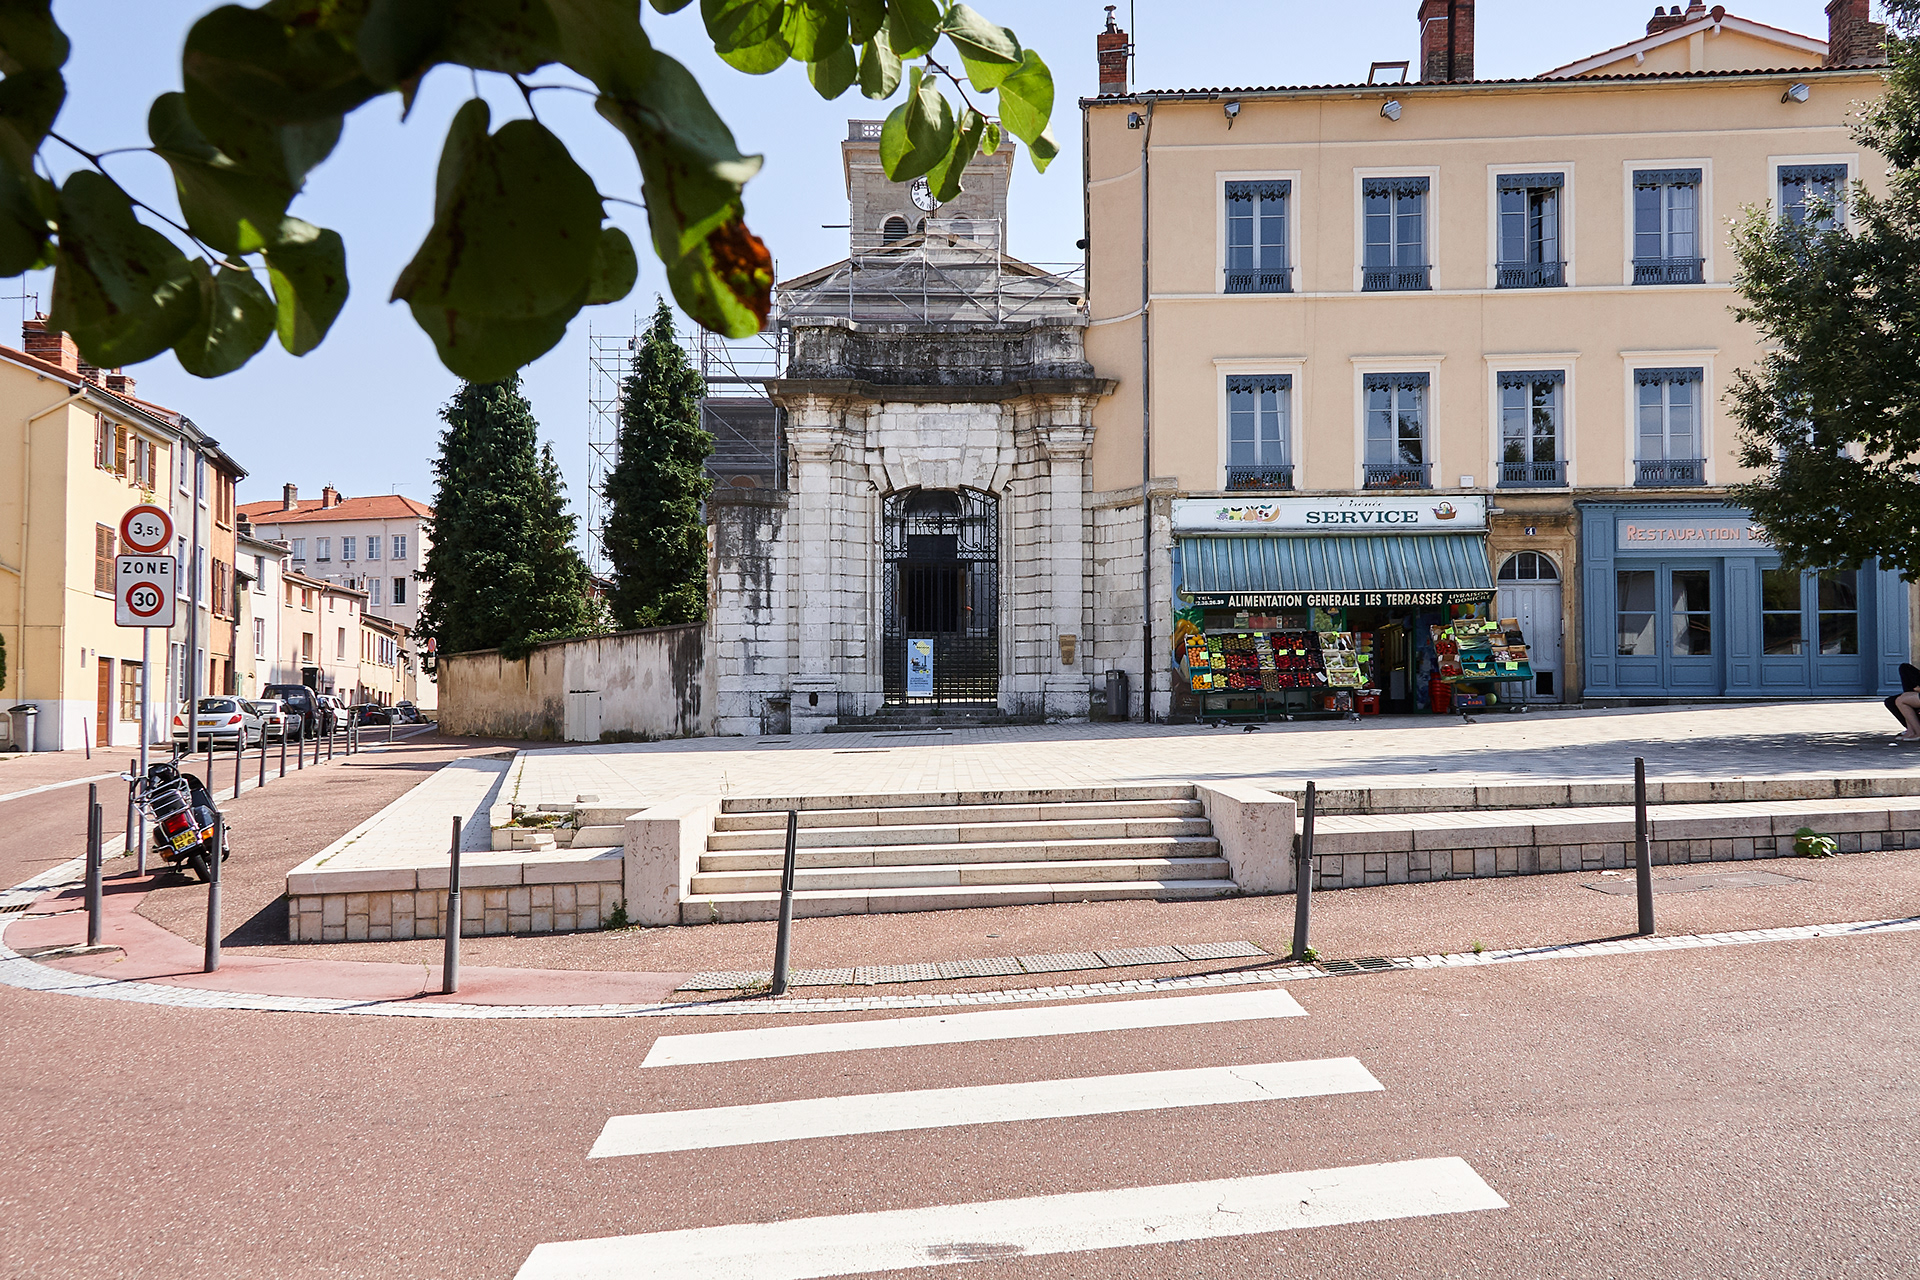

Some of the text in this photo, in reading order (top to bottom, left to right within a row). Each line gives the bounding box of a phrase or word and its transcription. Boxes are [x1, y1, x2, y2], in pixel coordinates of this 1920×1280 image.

[1306, 511, 1418, 523] SERVICE
[1627, 525, 1740, 540] RESTAURATION
[122, 562, 168, 574] ZONE
[133, 592, 157, 607] 30
[1228, 593, 1444, 607] ALIMENTATION GENERALE LES TERRASSES
[1449, 591, 1490, 600] LIVRAISON
[1454, 594, 1491, 604] DOMICILE
